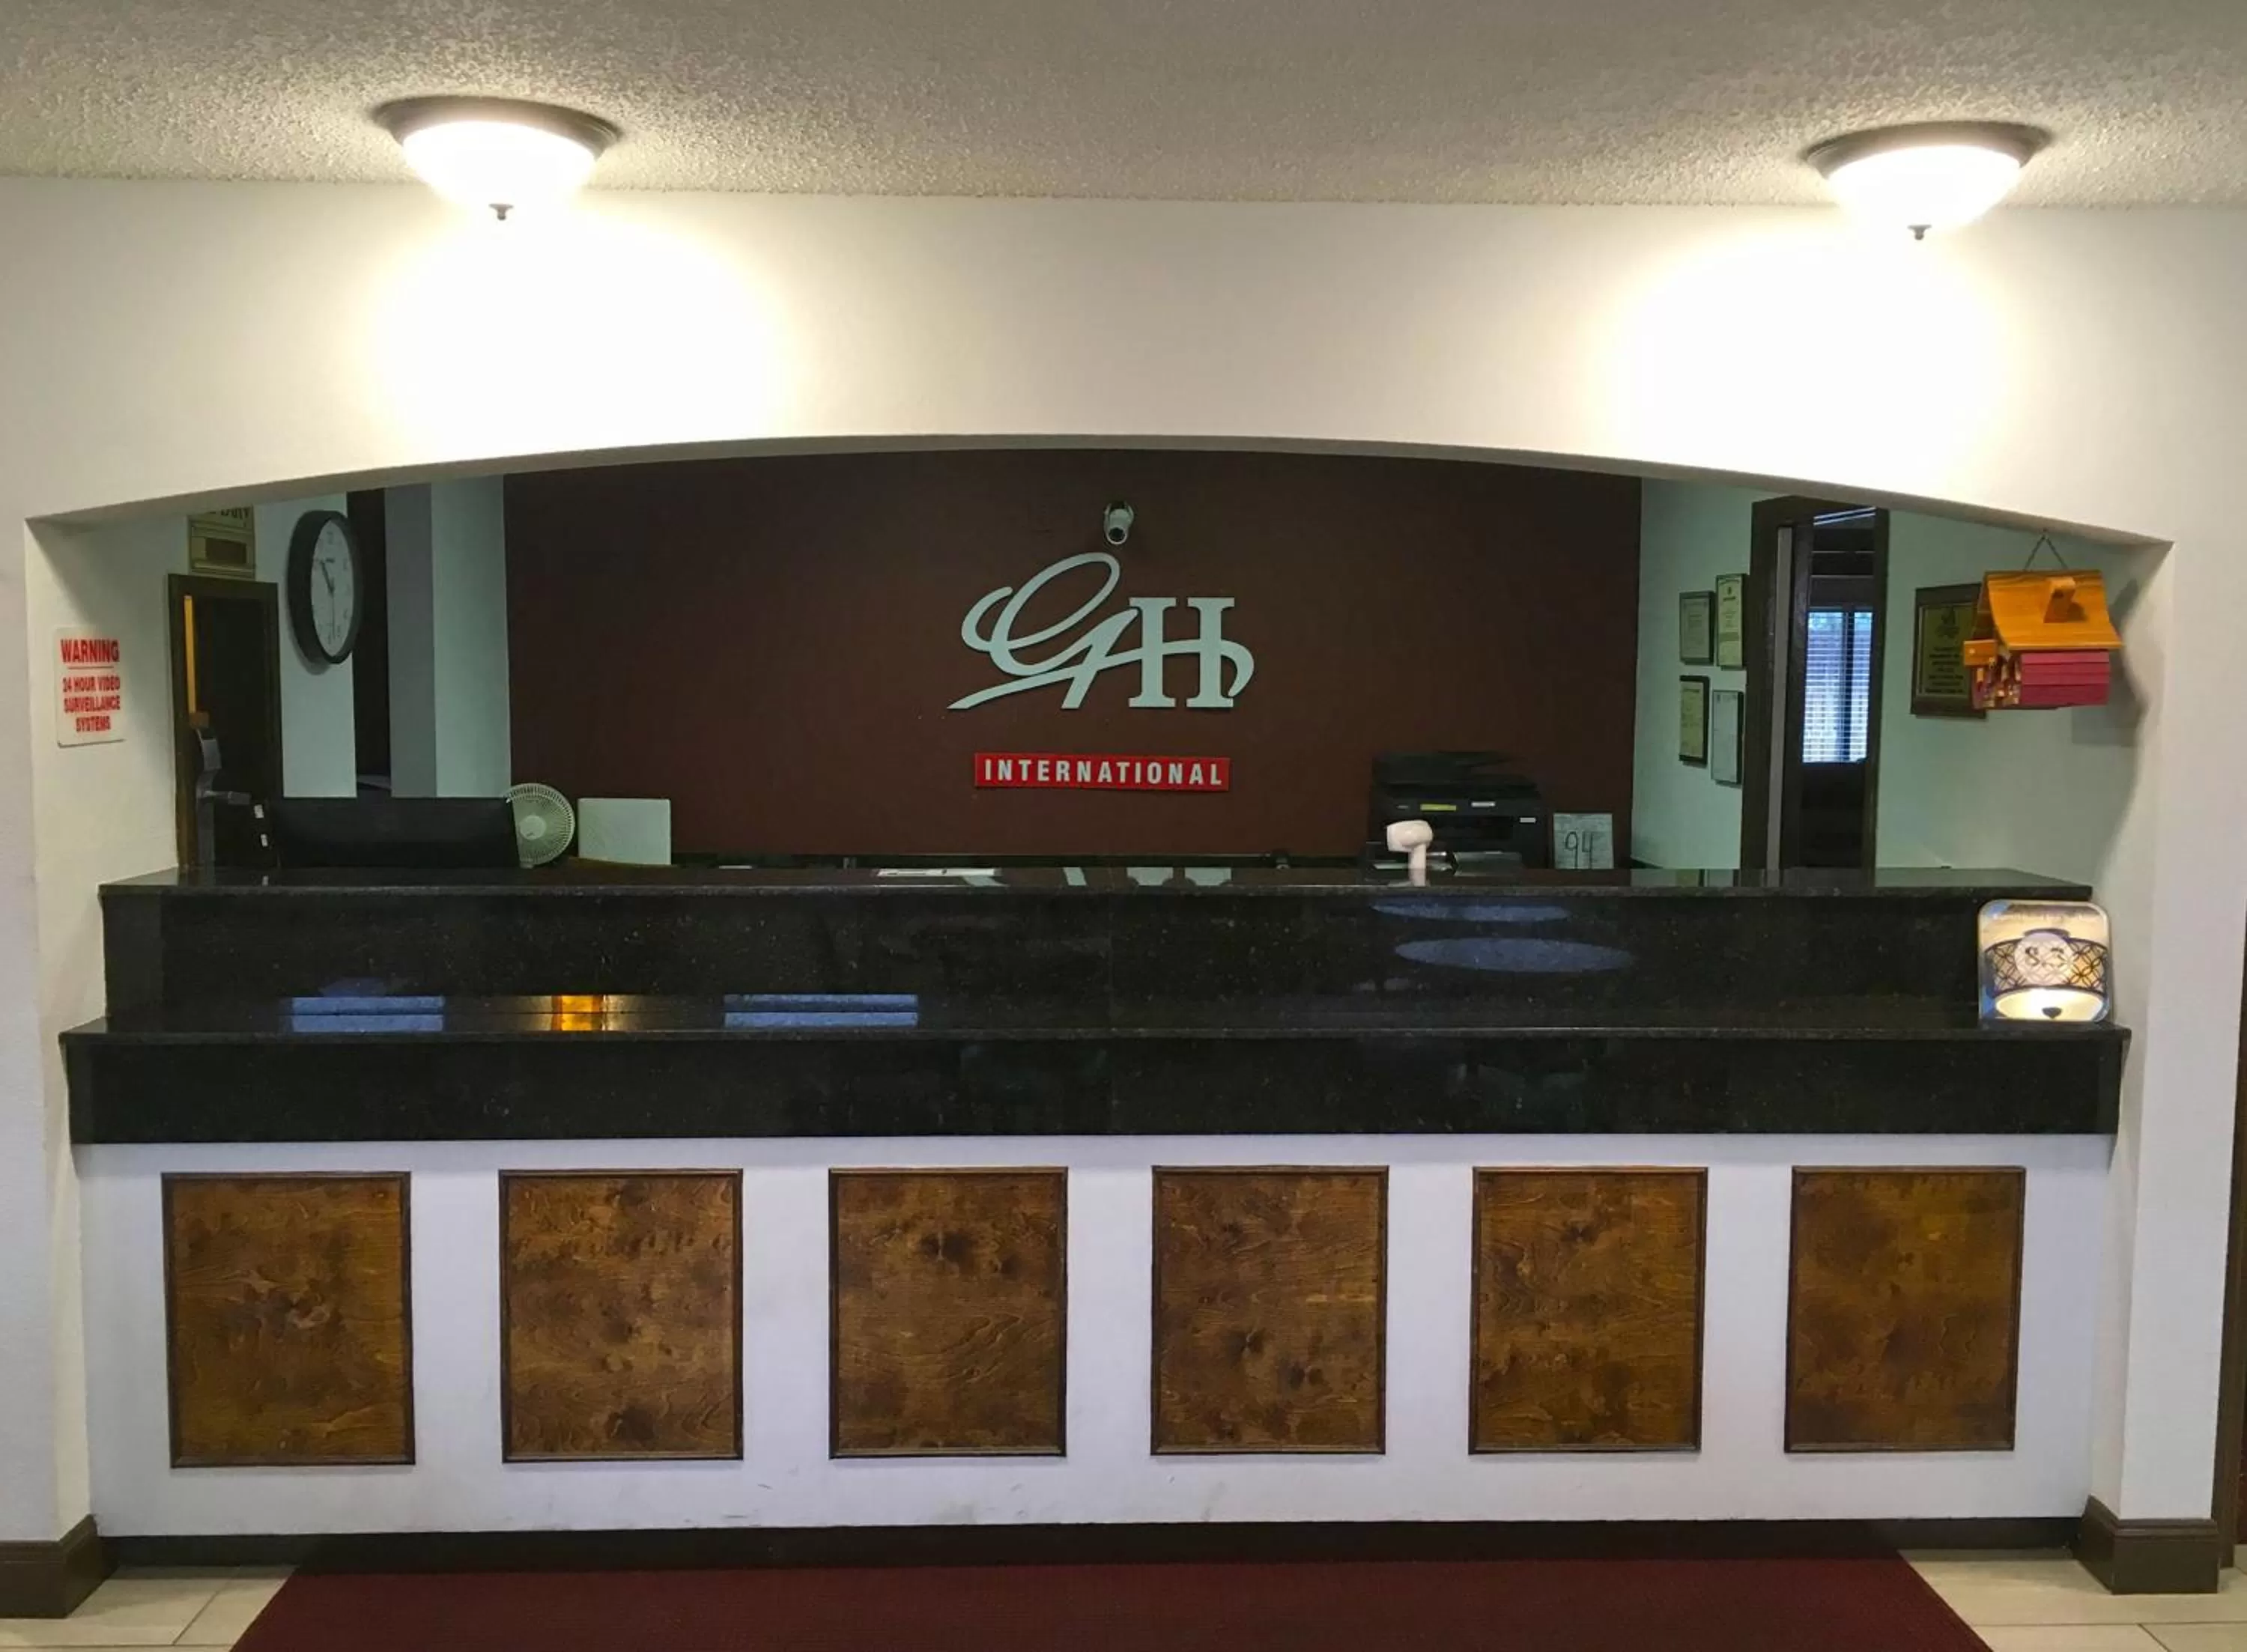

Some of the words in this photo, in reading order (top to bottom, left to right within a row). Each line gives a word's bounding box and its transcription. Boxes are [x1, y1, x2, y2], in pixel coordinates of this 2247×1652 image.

[60, 639, 120, 663] WARNING
[63, 677, 72, 692] 24
[73, 676, 95, 692] HOUR
[98, 675, 121, 691] VIDEO
[64, 695, 121, 713] SURVEILLANCE
[76, 715, 111, 732] SYSTEMS
[984, 758, 1222, 786] INTERNATIONAL
